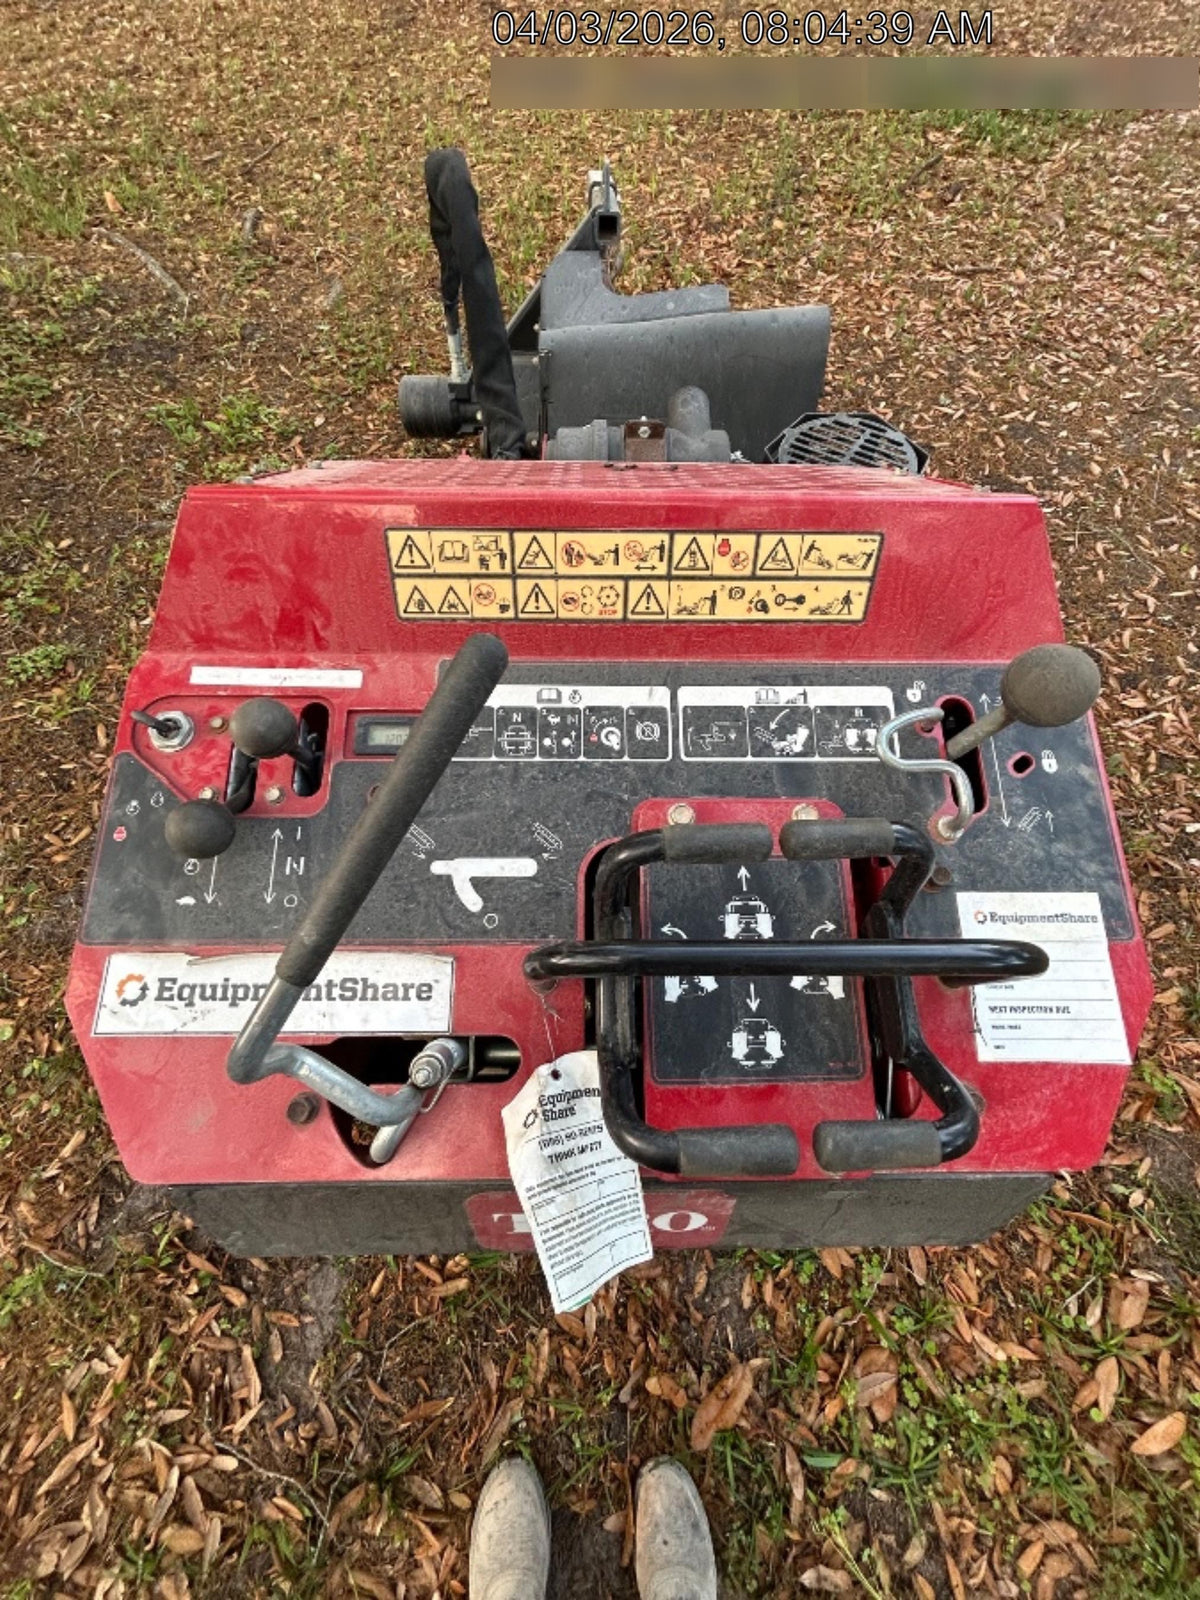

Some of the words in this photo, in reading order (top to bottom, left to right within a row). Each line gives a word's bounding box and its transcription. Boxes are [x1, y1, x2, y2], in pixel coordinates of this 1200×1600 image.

[513, 713, 522, 722] N
[285, 856, 305, 876] N
[989, 911, 1099, 926] EquipmentShare
[154, 976, 434, 1007] EquipntShare
[538, 1087, 602, 1109] Equipmen
[541, 1107, 577, 1123] Share
